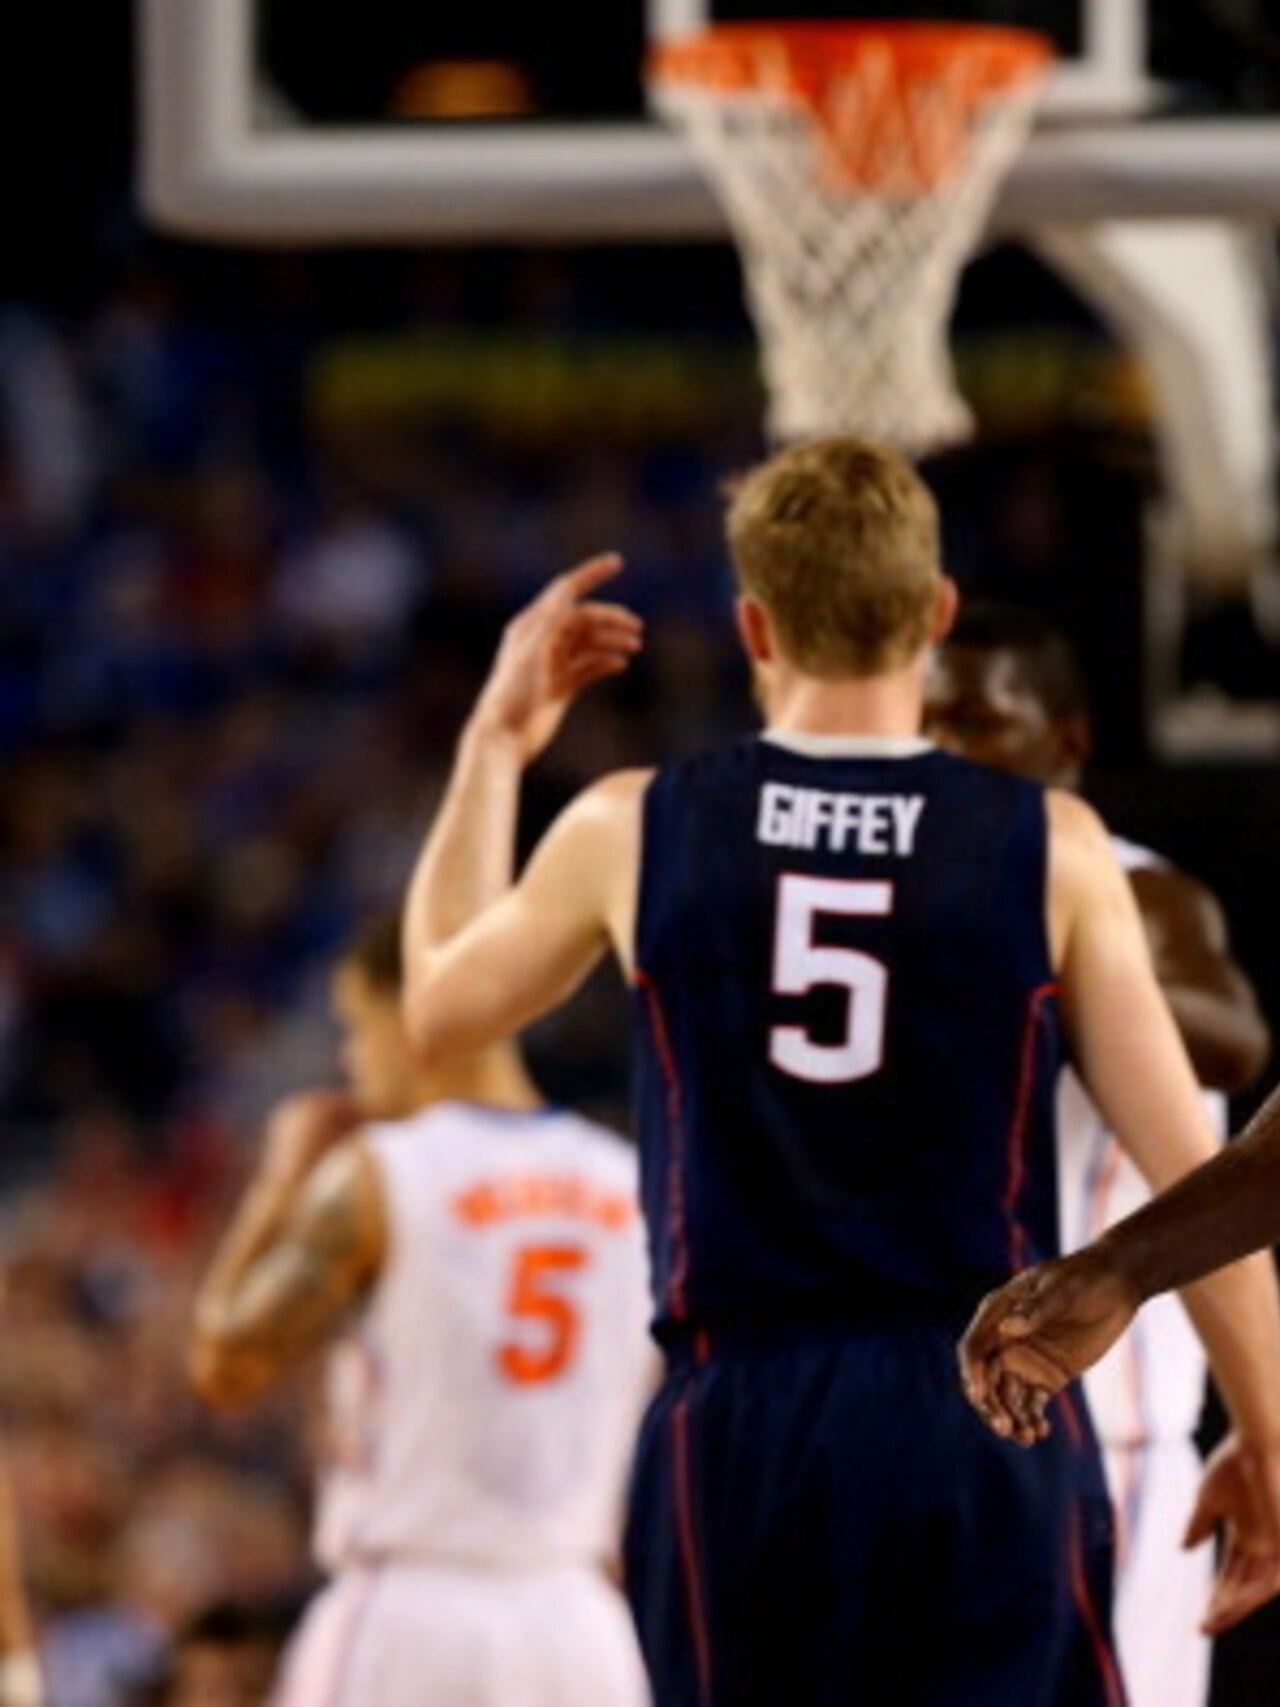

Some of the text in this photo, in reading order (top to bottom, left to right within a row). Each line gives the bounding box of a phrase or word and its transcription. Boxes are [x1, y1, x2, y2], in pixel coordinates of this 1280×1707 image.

[757, 782, 924, 856] GIFFEY
[768, 870, 894, 1084] 5
[498, 1244, 588, 1386] 5
